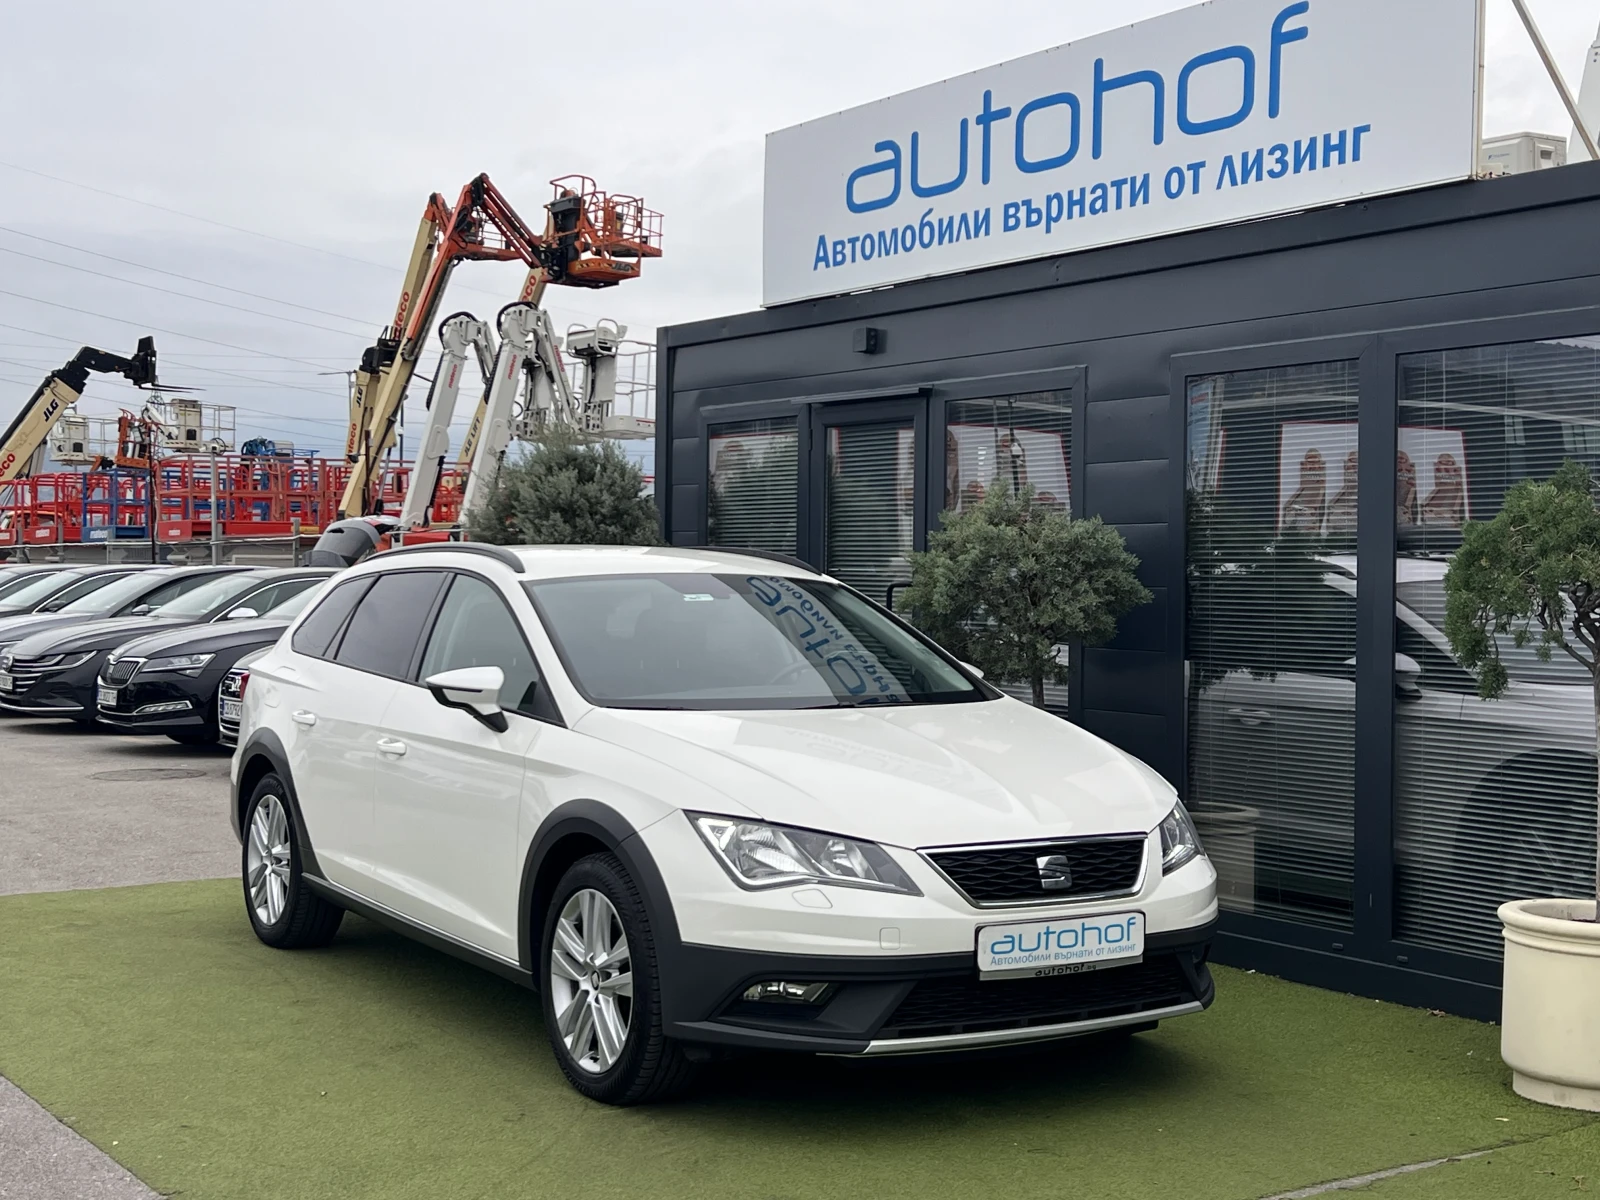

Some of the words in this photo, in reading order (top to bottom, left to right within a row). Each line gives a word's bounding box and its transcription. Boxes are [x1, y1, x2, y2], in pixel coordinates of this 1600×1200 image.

[846, 1, 1309, 214] autohof
[814, 208, 991, 271] Автомобили
[1003, 174, 1150, 234] върнати
[1163, 161, 1206, 199] от
[1216, 125, 1371, 190] лизинг
[43, 398, 60, 423] JLG
[990, 916, 1137, 955] autohof
[990, 951, 1051, 966] Автомобили
[1054, 949, 1093, 961] върнати
[1095, 947, 1105, 956] от
[1107, 943, 1137, 955] лизинг
